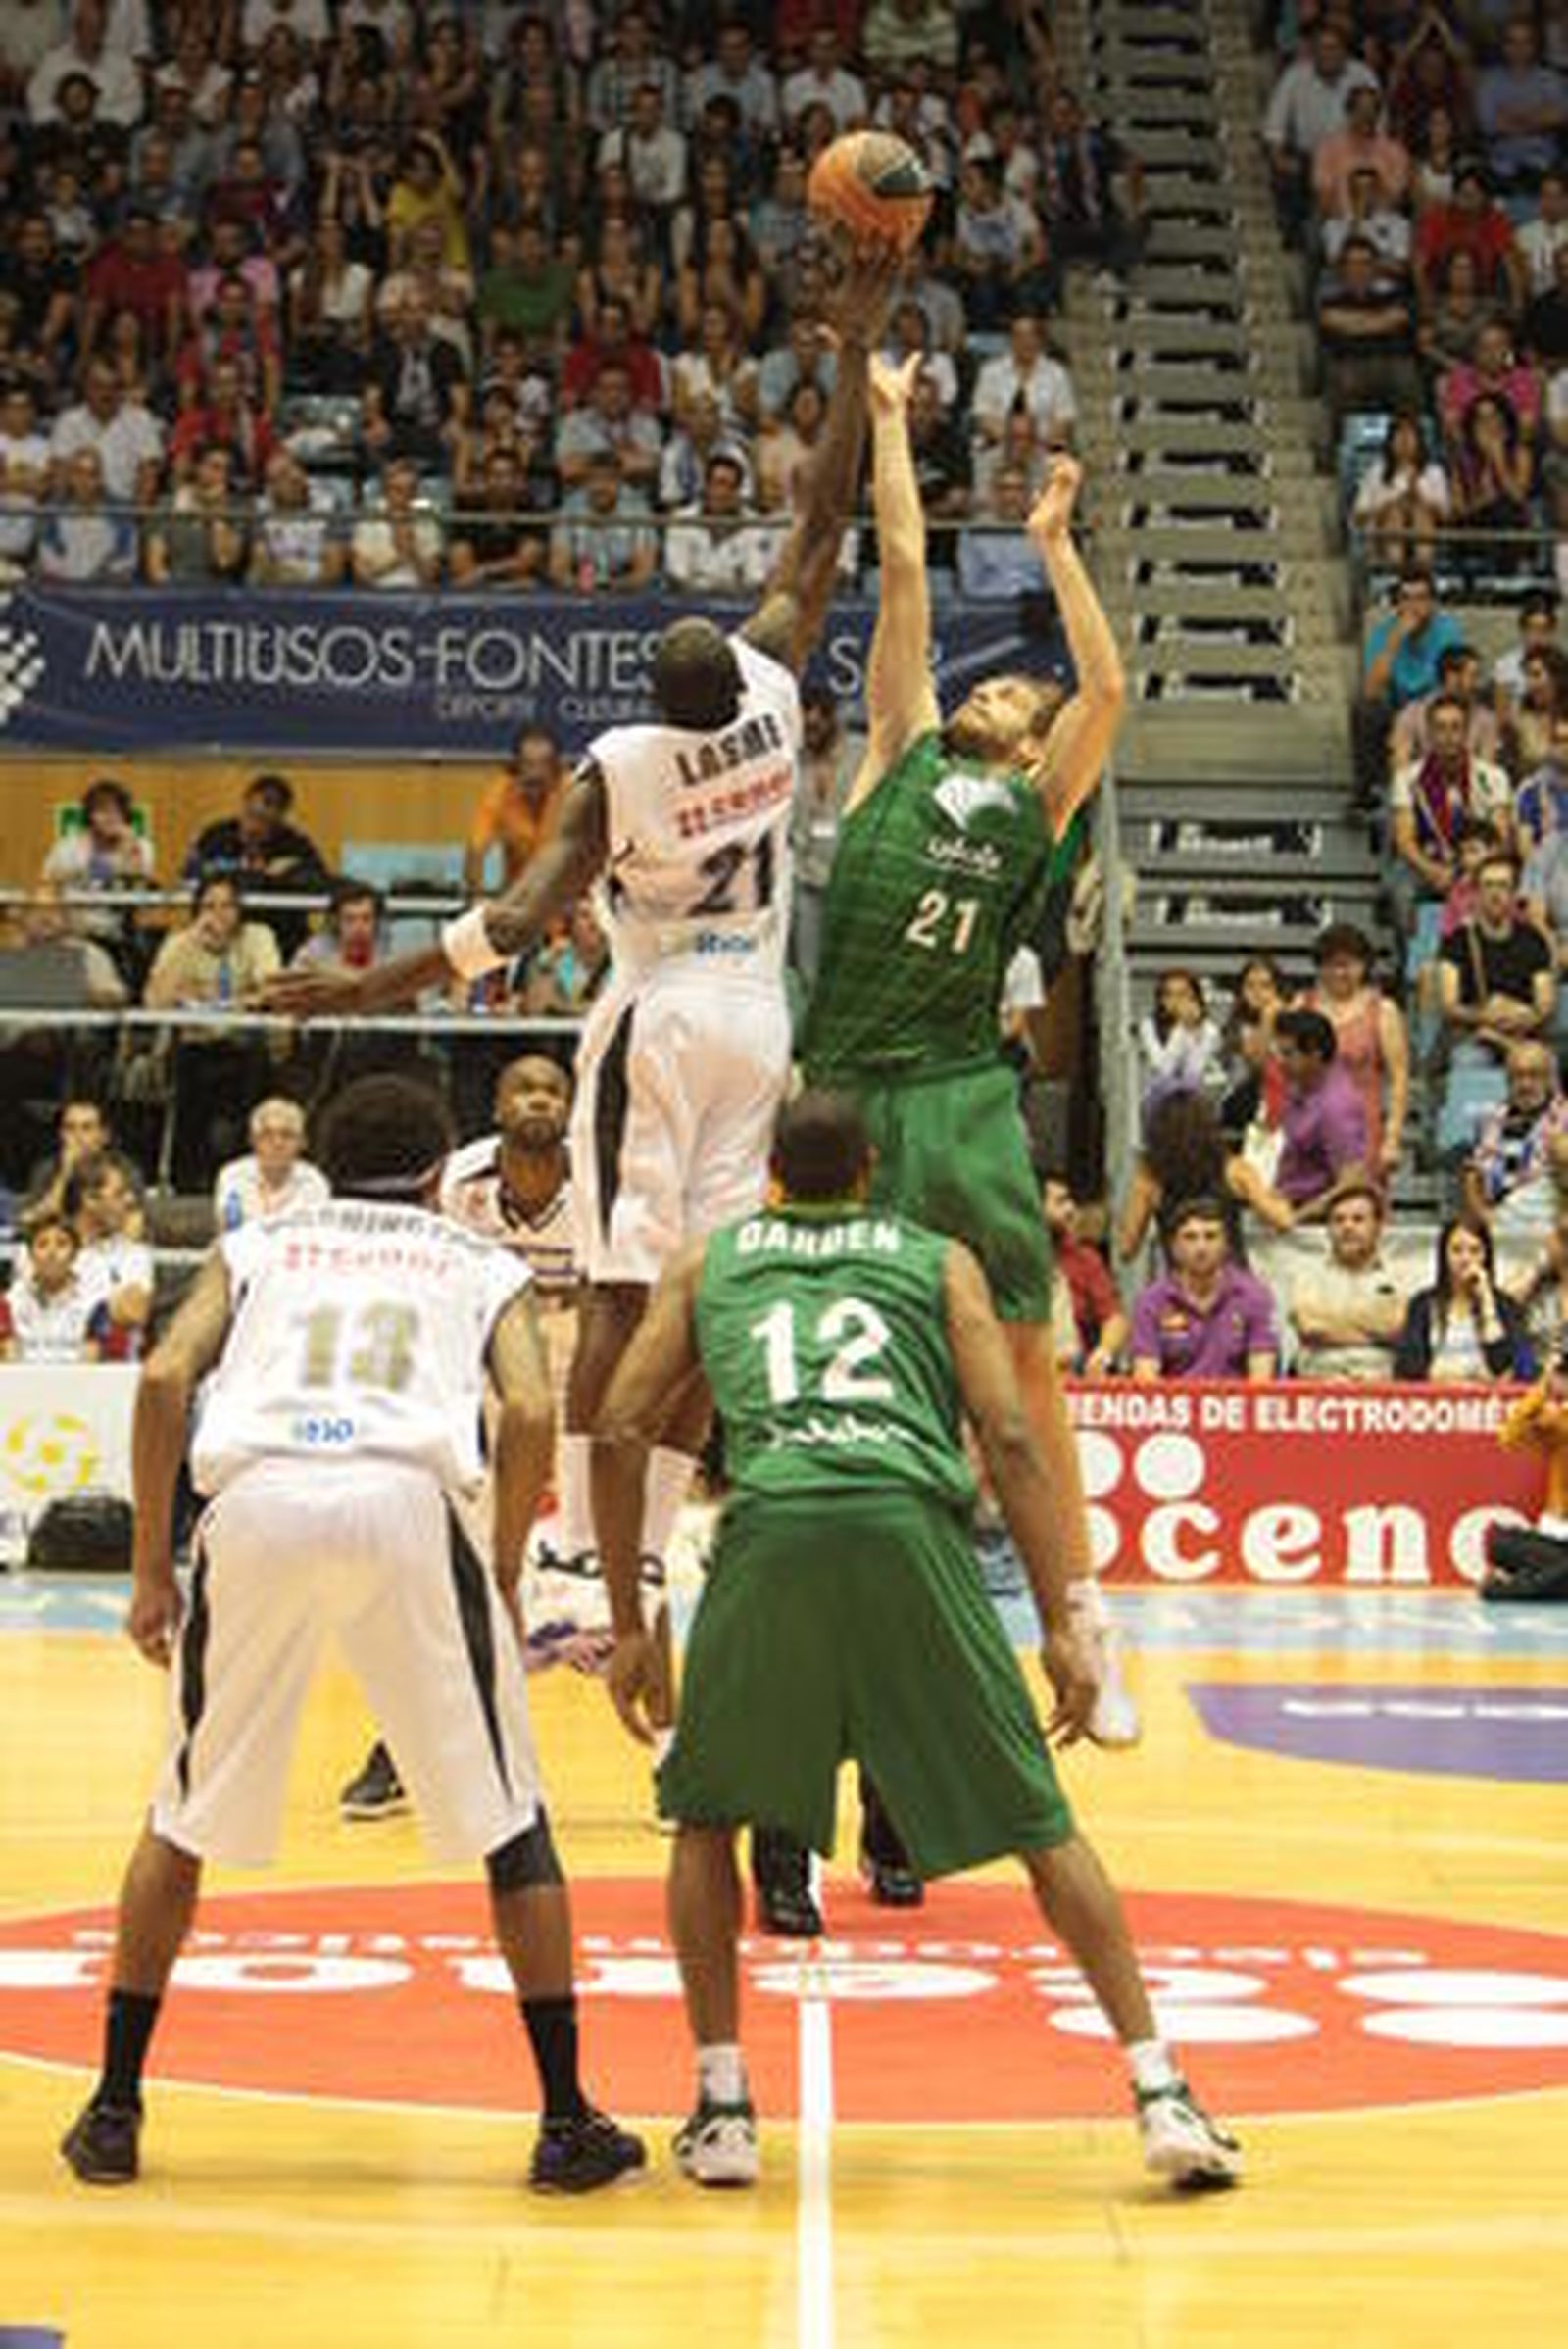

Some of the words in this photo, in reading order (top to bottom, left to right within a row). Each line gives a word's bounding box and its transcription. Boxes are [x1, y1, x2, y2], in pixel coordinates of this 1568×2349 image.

[685, 830, 775, 917] 21
[905, 888, 980, 954] 21
[290, 1299, 420, 1394] 13
[750, 1296, 894, 1405] 12
[1202, 1395, 1246, 1432] DE
